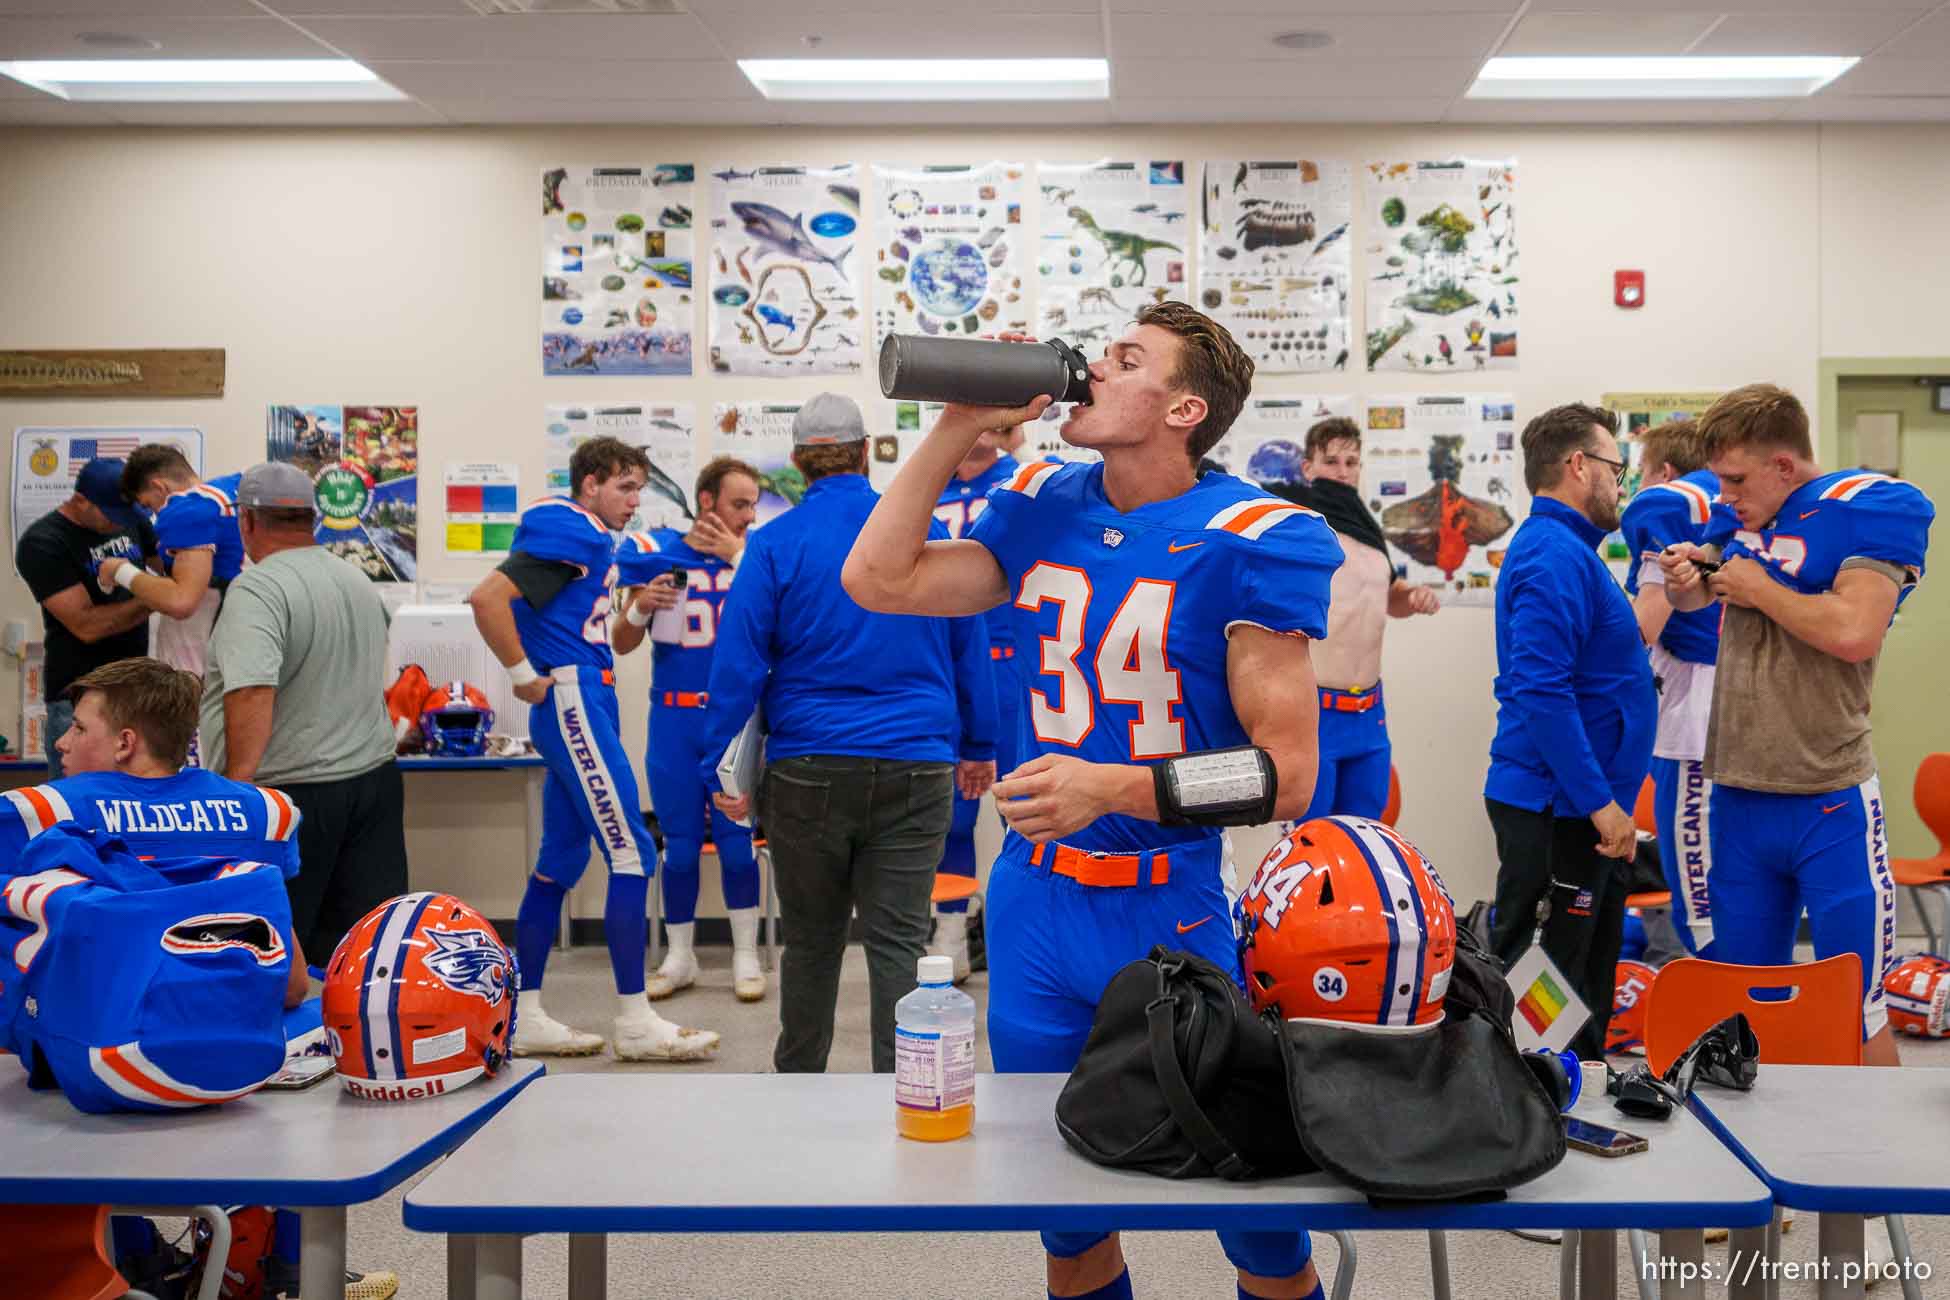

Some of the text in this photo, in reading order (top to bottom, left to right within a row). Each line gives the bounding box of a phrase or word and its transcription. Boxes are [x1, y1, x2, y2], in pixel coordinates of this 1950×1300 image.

[1015, 560, 1187, 761] 34
[96, 799, 249, 833] WILDCATS
[562, 706, 627, 850] WATER CANYON
[1248, 837, 1314, 929] 34
[1683, 760, 1712, 920] WATER CANYON
[1317, 975, 1343, 996] 34
[347, 1078, 446, 1102] Riddell
